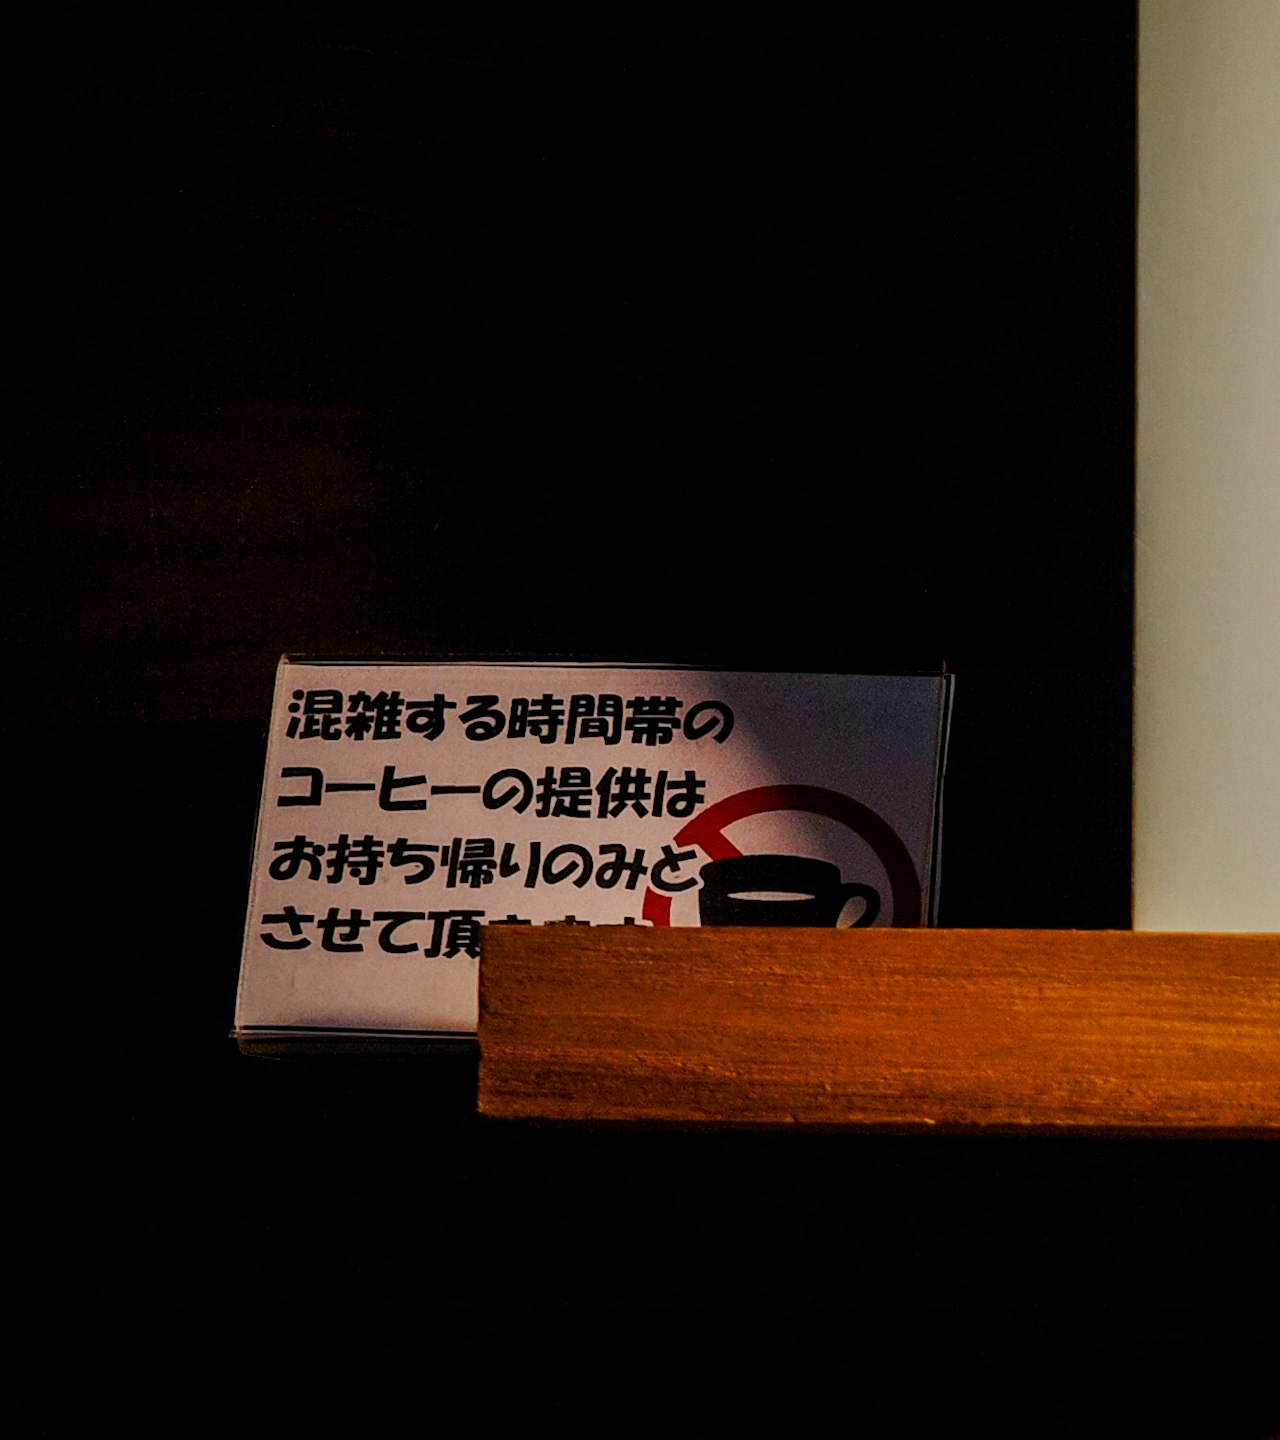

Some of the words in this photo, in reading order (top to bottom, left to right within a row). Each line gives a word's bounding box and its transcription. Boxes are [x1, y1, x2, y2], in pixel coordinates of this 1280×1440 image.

[286, 689, 735, 746] 混雑する時間帯の
[275, 766, 706, 819] コーヒーの提供は
[268, 834, 701, 891] お持ち帰りのみと
